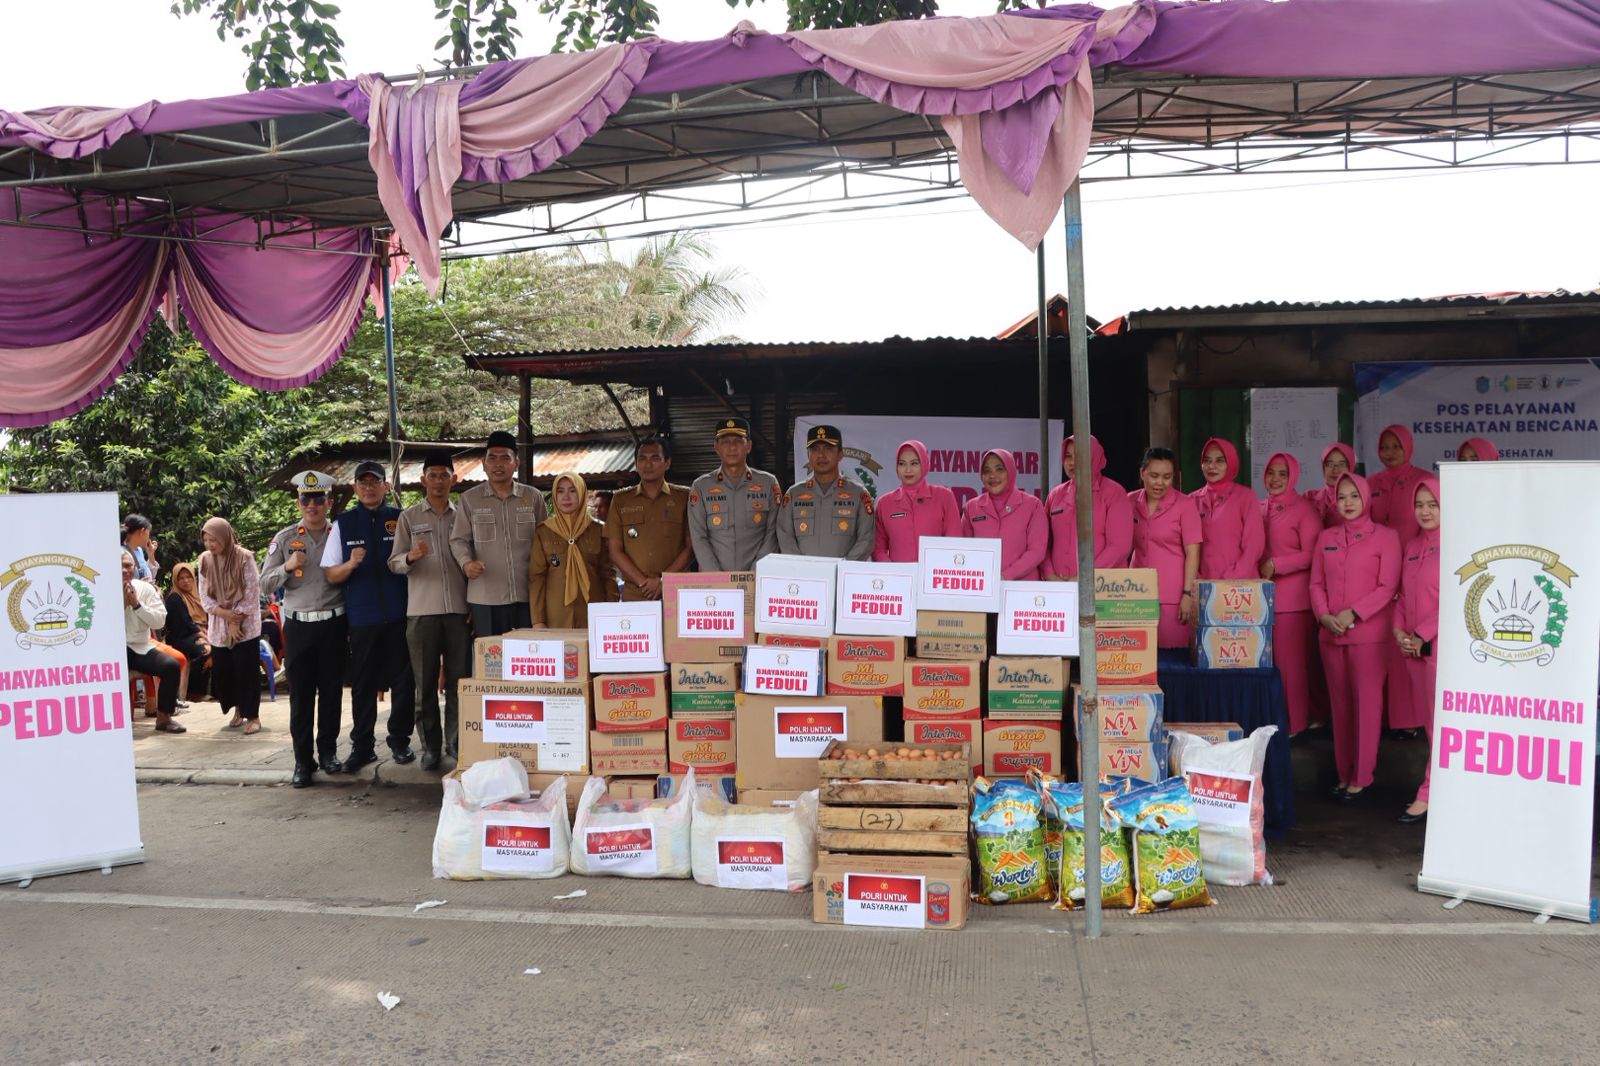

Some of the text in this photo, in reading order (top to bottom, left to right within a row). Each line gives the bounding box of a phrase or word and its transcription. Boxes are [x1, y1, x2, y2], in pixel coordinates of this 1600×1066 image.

[1437, 402, 1575, 416] POS PELAYANAN
[1412, 420, 1599, 434] KESEHATAN BENCANA
[1478, 547, 1552, 565] BHAYANGKARI
[933, 568, 985, 577] BHAYANGKARI
[932, 577, 984, 591] PEDULI
[768, 598, 818, 607] BHAYANGKARI
[852, 594, 903, 602] BHAYANGKARI
[687, 610, 735, 618] BHAYANGKARI
[768, 606, 818, 620] PEDULI
[852, 602, 902, 616] PEDULI
[1014, 610, 1065, 619] BHAYANGKARI
[687, 618, 735, 630] PEDULI
[1014, 619, 1065, 633] PEDULI
[603, 642, 650, 654] PEDULI
[512, 664, 556, 676] PEDULI
[756, 668, 808, 678] BHAYANGKARI
[856, 663, 874, 674] Mi
[842, 671, 888, 685] Goreng
[756, 678, 808, 692] PEDULI
[476, 686, 497, 694] HASTI
[498, 686, 535, 695] ANUGRAH
[536, 686, 583, 696] NUSANTARA
[933, 688, 950, 699] Mi
[622, 700, 639, 710] Mi
[918, 697, 965, 710] Goreng
[1442, 690, 1584, 724] BHAYANGKARI
[608, 709, 652, 721] Goreng
[696, 742, 713, 752] Mi
[682, 752, 727, 762] Goreng
[1438, 726, 1584, 786] PEDULI
[1194, 787, 1238, 801] POLRI UNTUK
[1192, 796, 1237, 809] MASYARAKAT
[517, 840, 539, 848] UNTUK
[598, 842, 641, 853] POLRI UNTUK
[496, 849, 539, 857] MASYARAKAT
[598, 852, 642, 861] MASYARAKAT
[860, 892, 908, 902] POLRI UNTUK
[860, 902, 908, 912] MASYARAKAT
